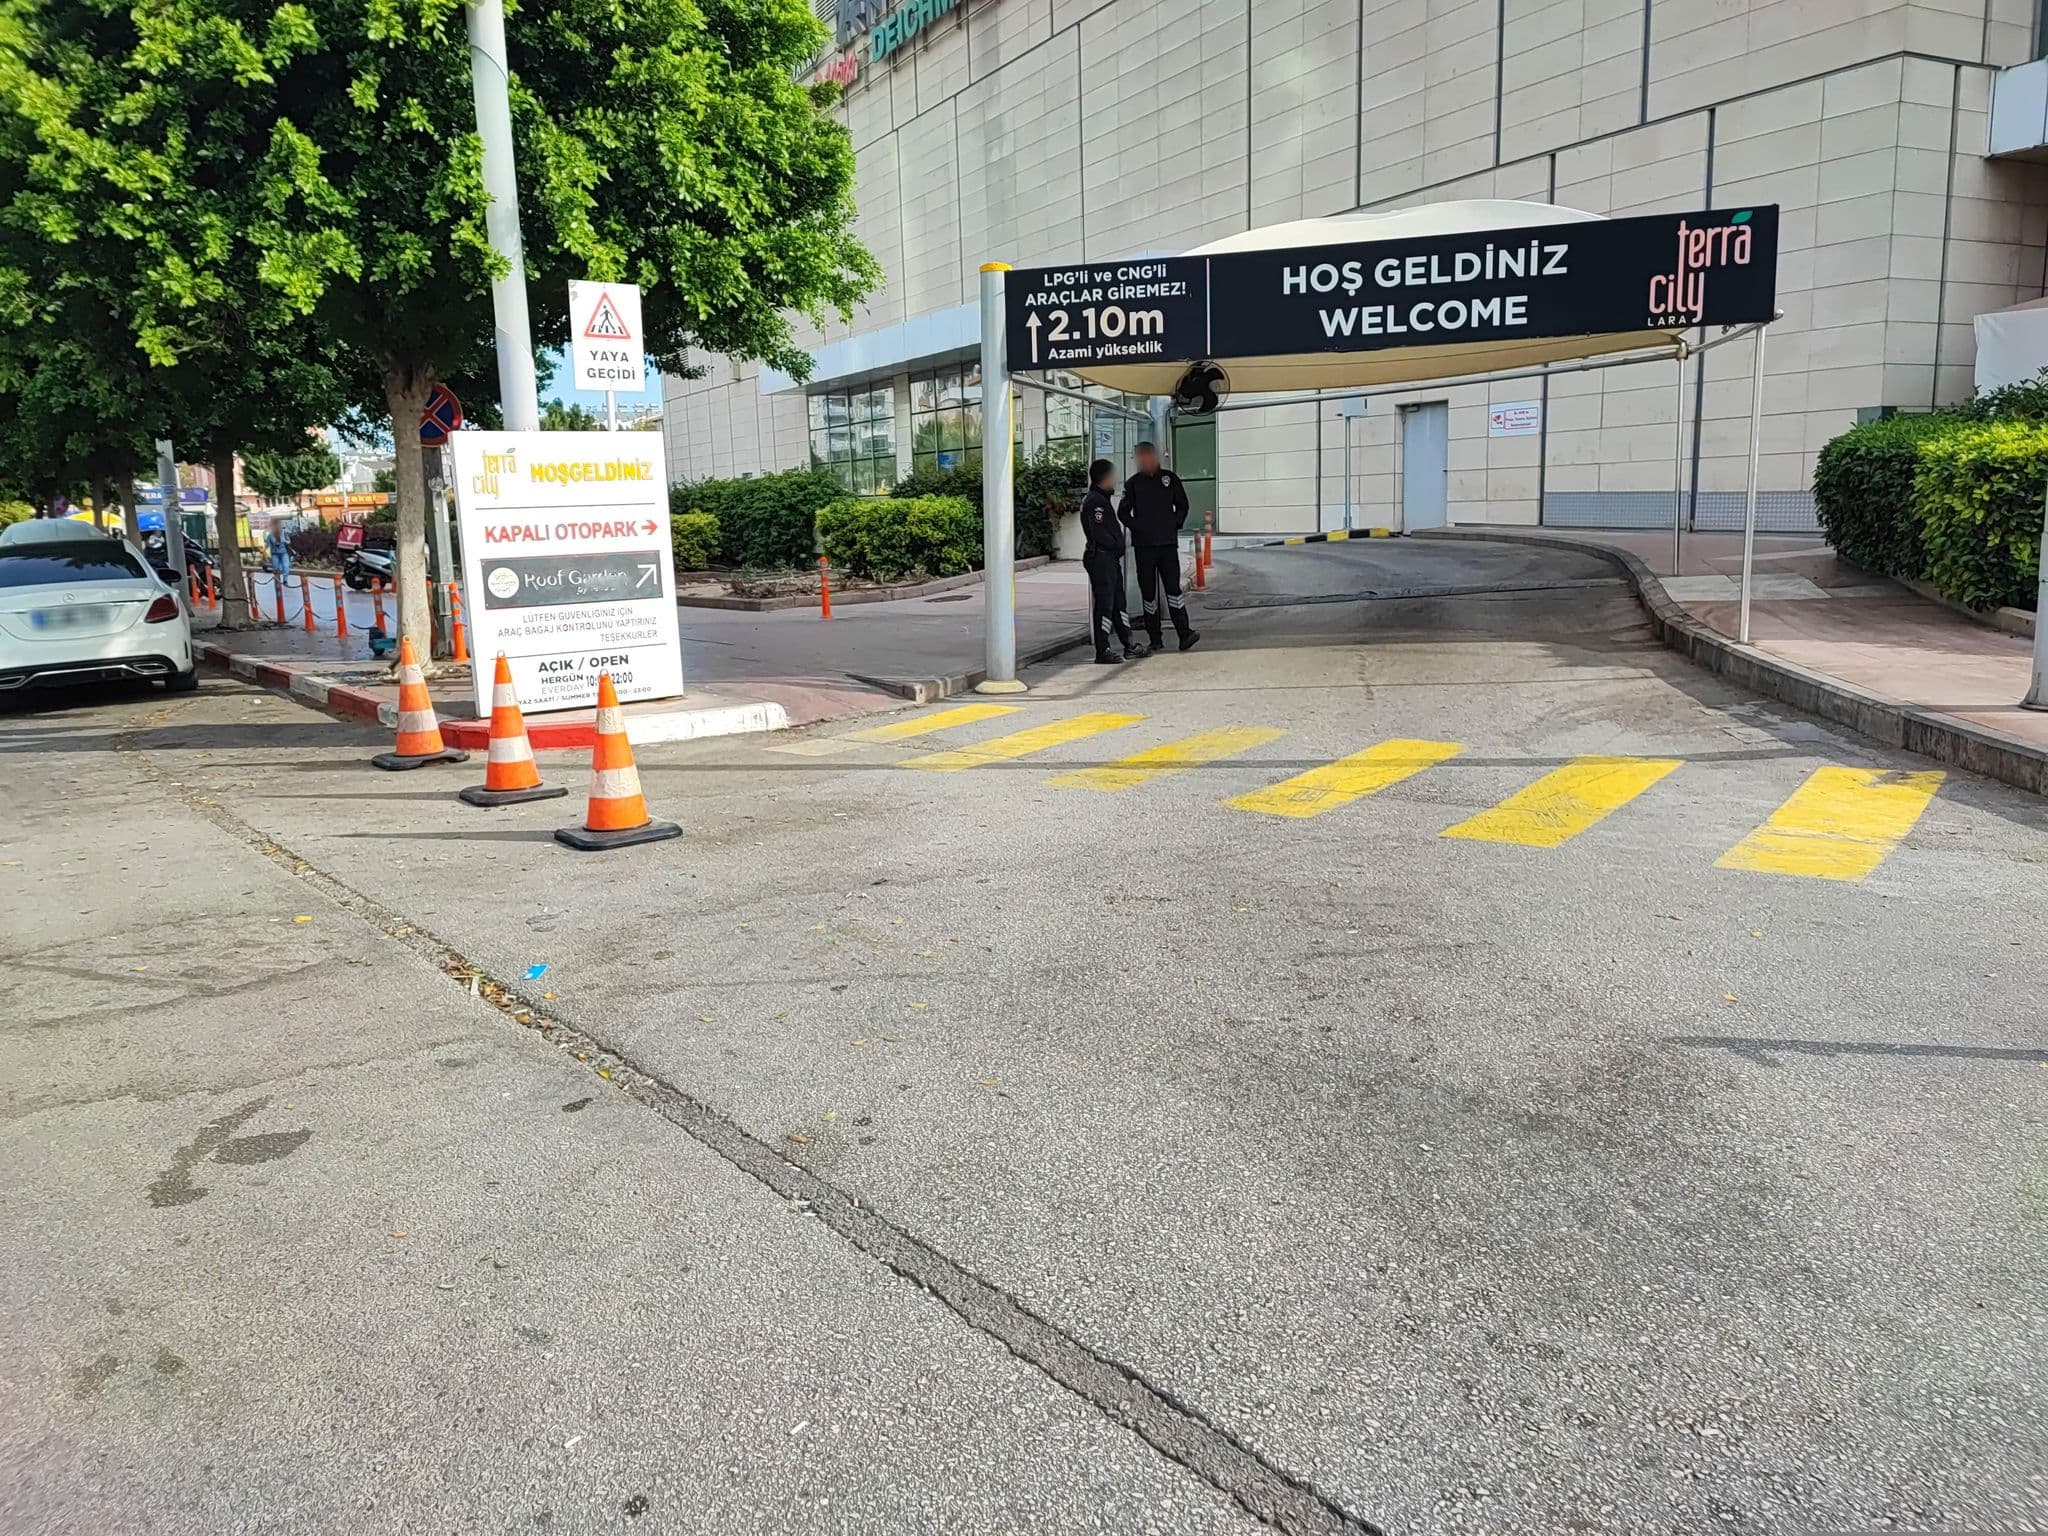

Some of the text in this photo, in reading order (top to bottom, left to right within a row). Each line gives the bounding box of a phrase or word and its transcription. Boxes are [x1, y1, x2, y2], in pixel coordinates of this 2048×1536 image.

[1677, 220, 1752, 268] terra
[1044, 264, 1167, 286] LPG'li ve CNG'li
[1282, 239, 1569, 297] HOŞ GELDİNİZ
[1025, 281, 1186, 306] ARAÇLAR GİREMEZ!
[1649, 272, 1705, 323] city
[1048, 305, 1164, 341] 2.10m
[1318, 295, 1529, 338] WELCOME
[1647, 315, 1687, 327] LARA
[589, 350, 629, 362] YAYA
[1048, 340, 1163, 360] Azami yükseklik
[587, 365, 636, 382] GEÇİDİ
[530, 458, 654, 487] HOŞGELDİNİZ
[484, 521, 639, 543] KAPALI OTOPARK
[498, 626, 523, 638] ARAÇ
[538, 654, 629, 674] AÇIK / OPEN
[541, 674, 583, 685] HERGÜN
[541, 684, 585, 695] EVERDAY
